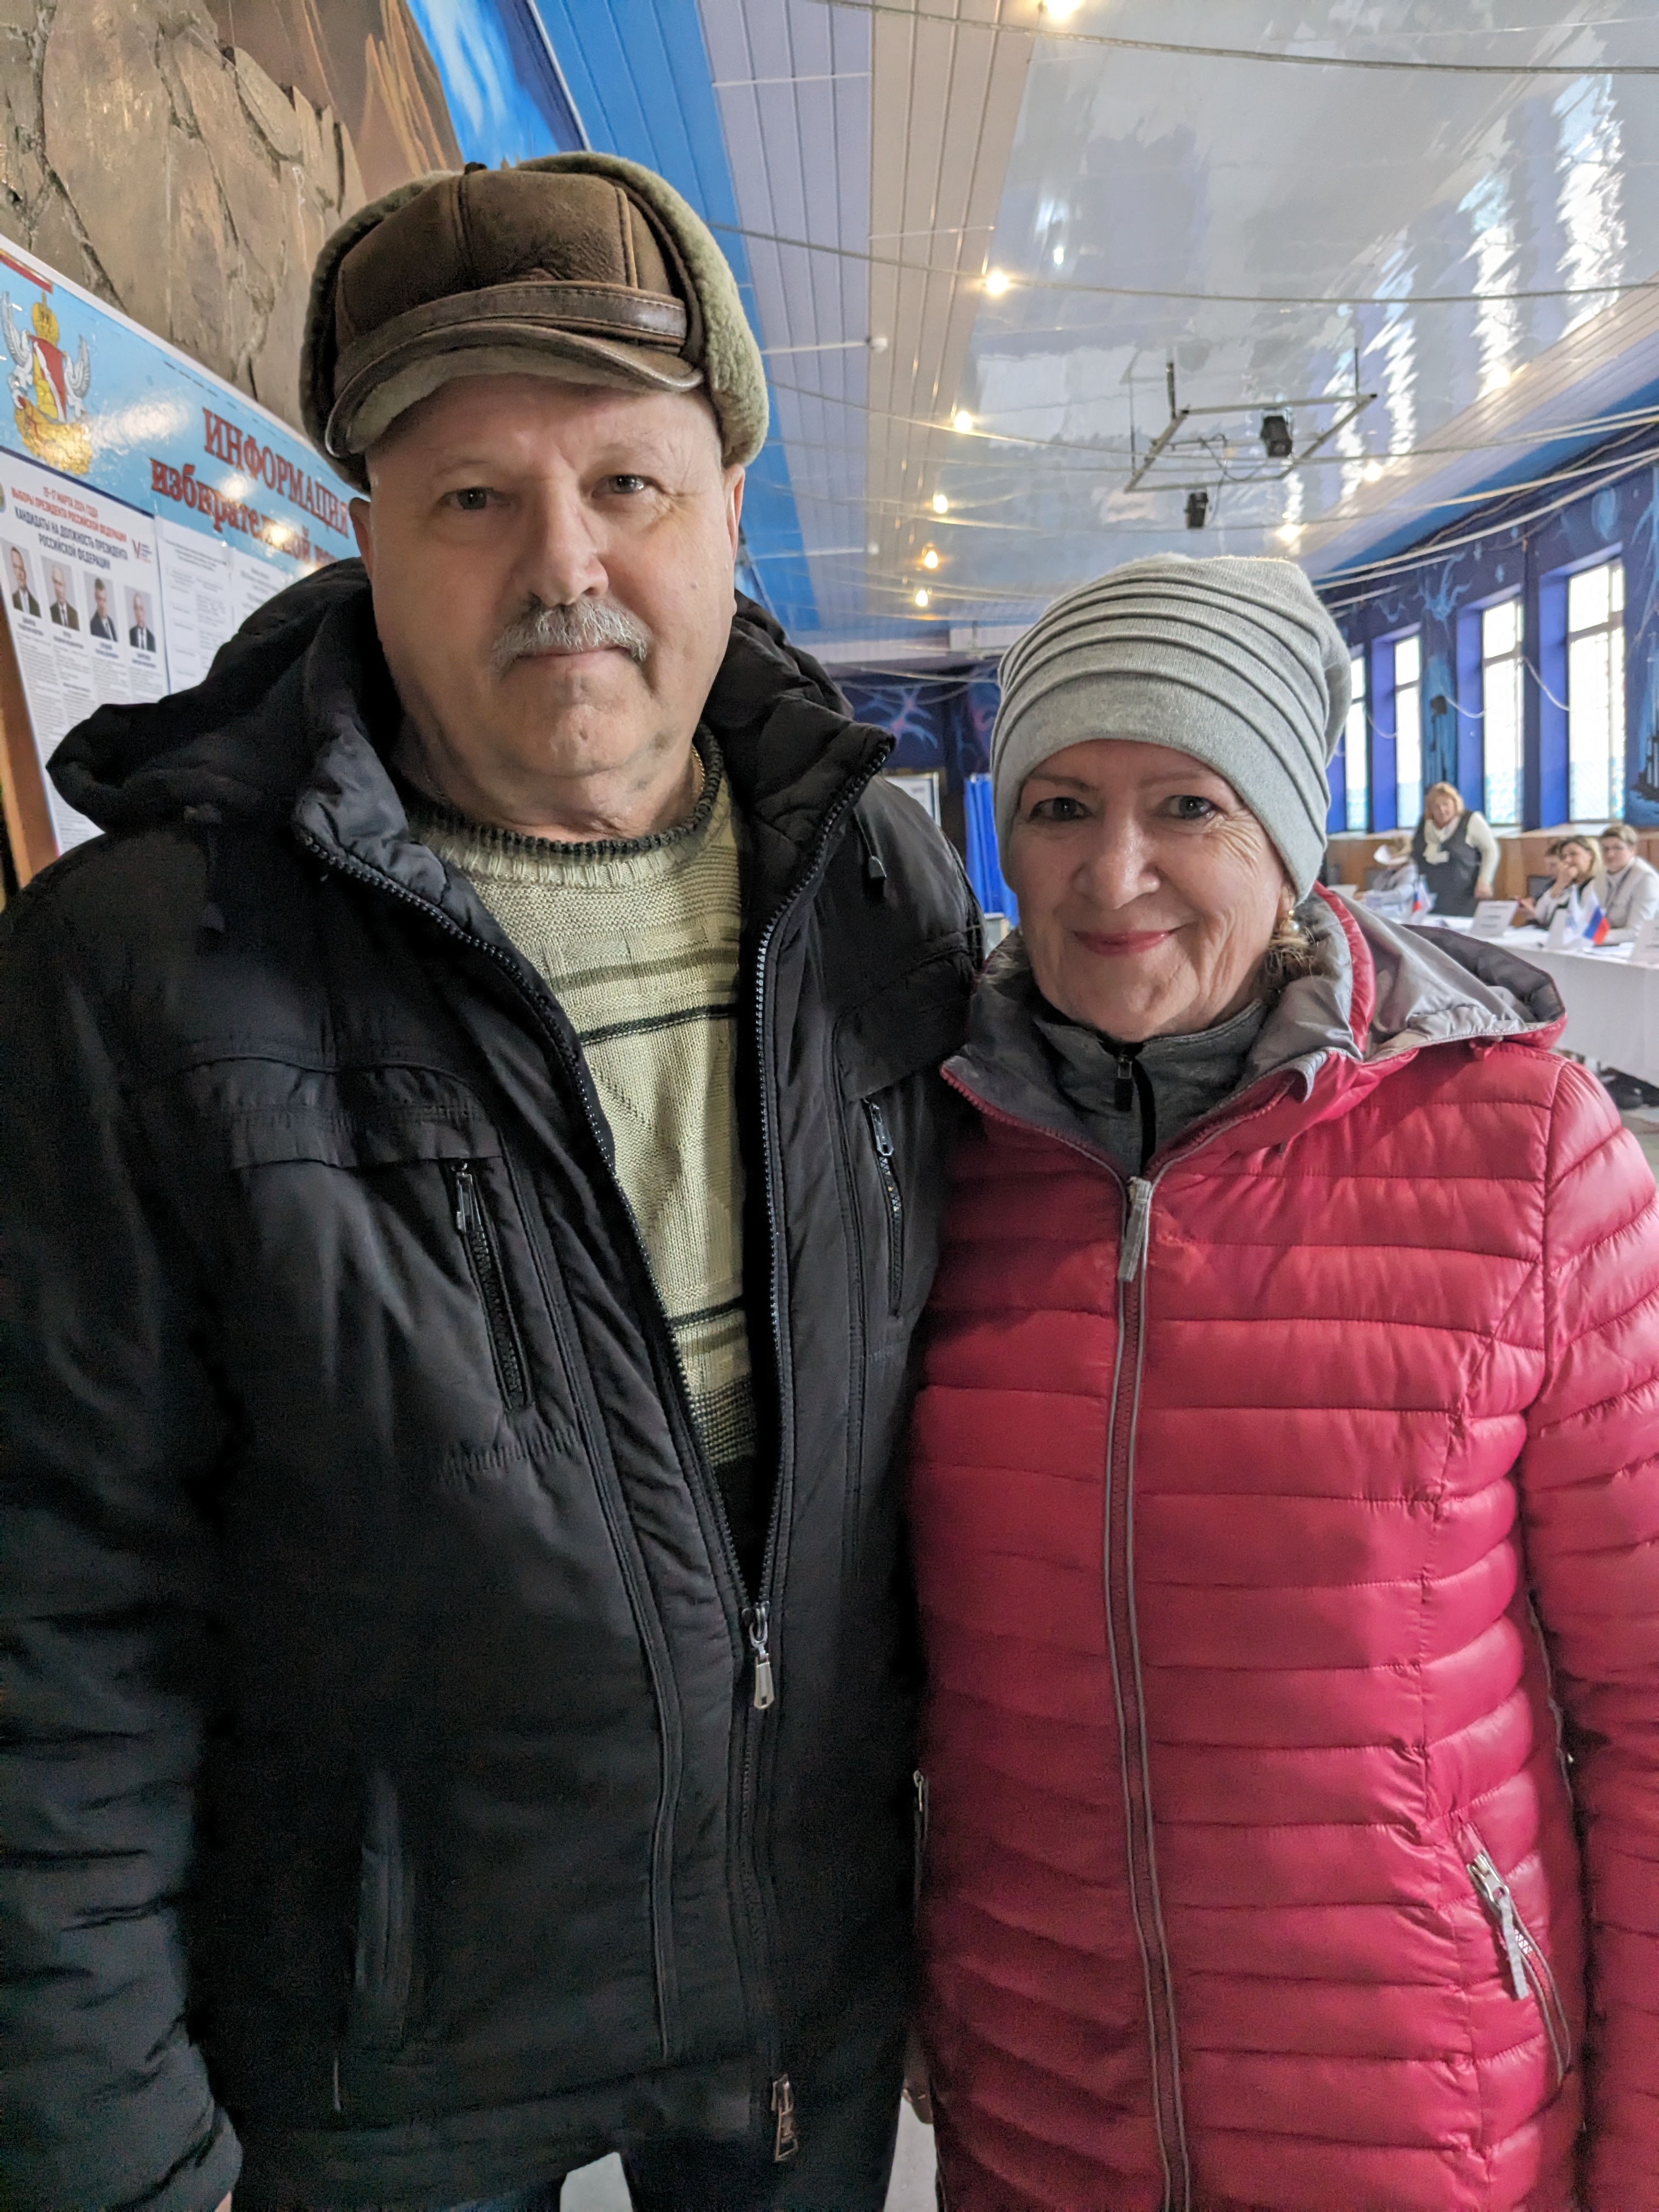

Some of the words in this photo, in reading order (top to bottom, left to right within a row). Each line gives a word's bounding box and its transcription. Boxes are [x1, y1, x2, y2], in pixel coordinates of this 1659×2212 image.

[149, 458, 312, 564] избиратеой
[202, 407, 350, 539] ИНФОРМАЦИЯ
[14, 505, 50, 531] КАНДИДАТЫ
[60, 524, 95, 548] ДОЛЖНОСТЬ
[95, 538, 128, 561] ПРЕЗИДЕНТА
[38, 533, 77, 558] РОССИЙСКОЙ
